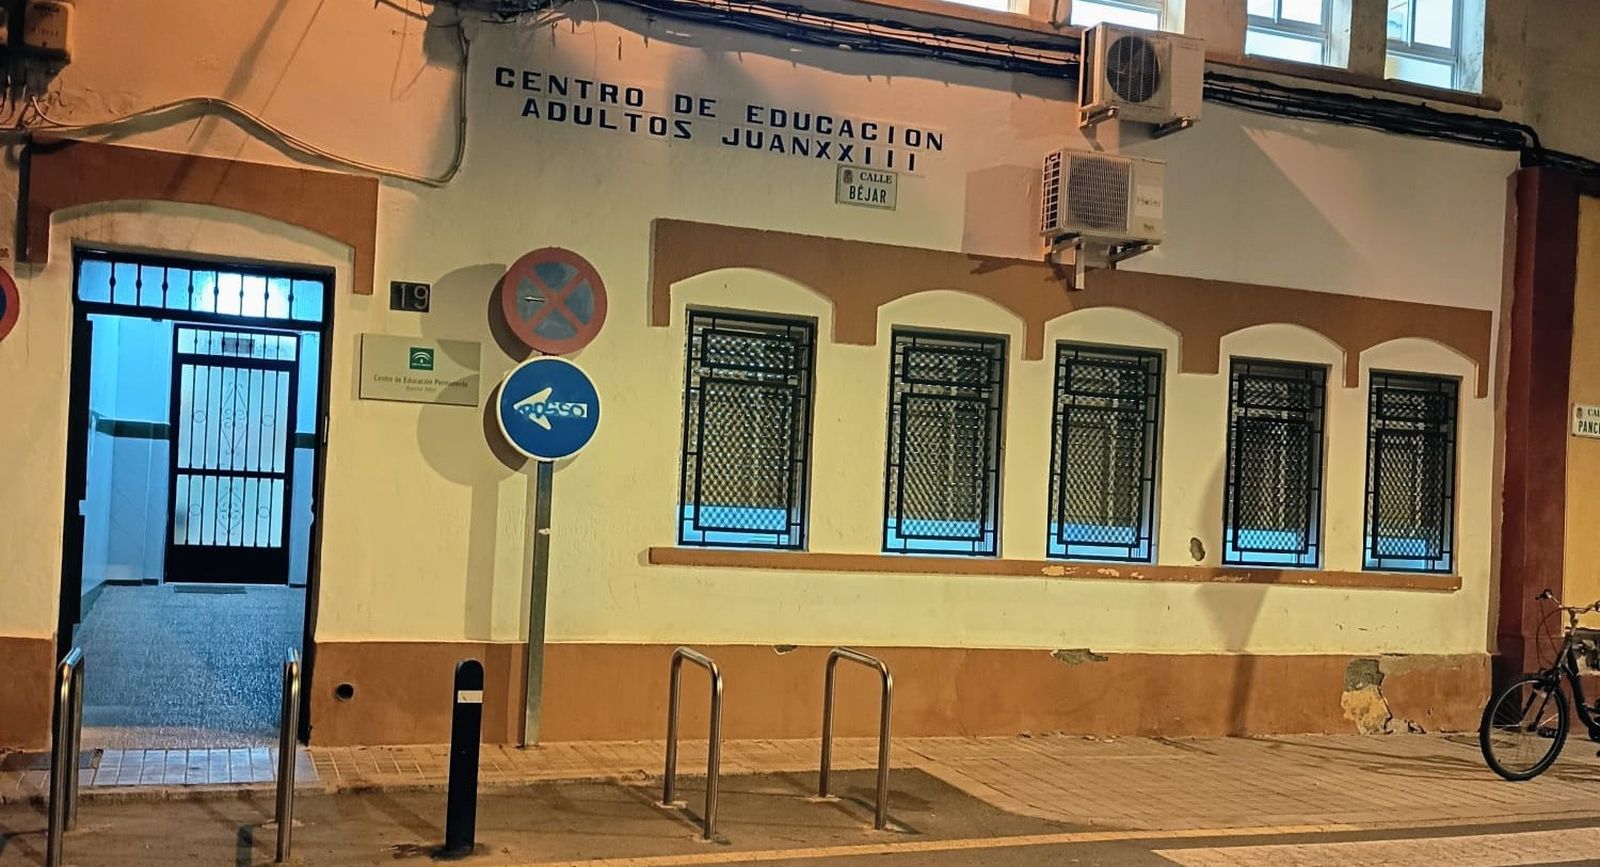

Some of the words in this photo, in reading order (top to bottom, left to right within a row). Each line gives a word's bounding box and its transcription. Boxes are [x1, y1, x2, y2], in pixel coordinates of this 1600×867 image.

[495, 66, 644, 108] CENTRO
[674, 94, 717, 118] DE
[746, 104, 943, 151] EDUCACION
[521, 97, 692, 140] ADULTOS
[860, 171, 893, 184] CALLE
[849, 183, 887, 204] BÉJAR
[400, 283, 429, 309] 19
[373, 374, 393, 383] Centro
